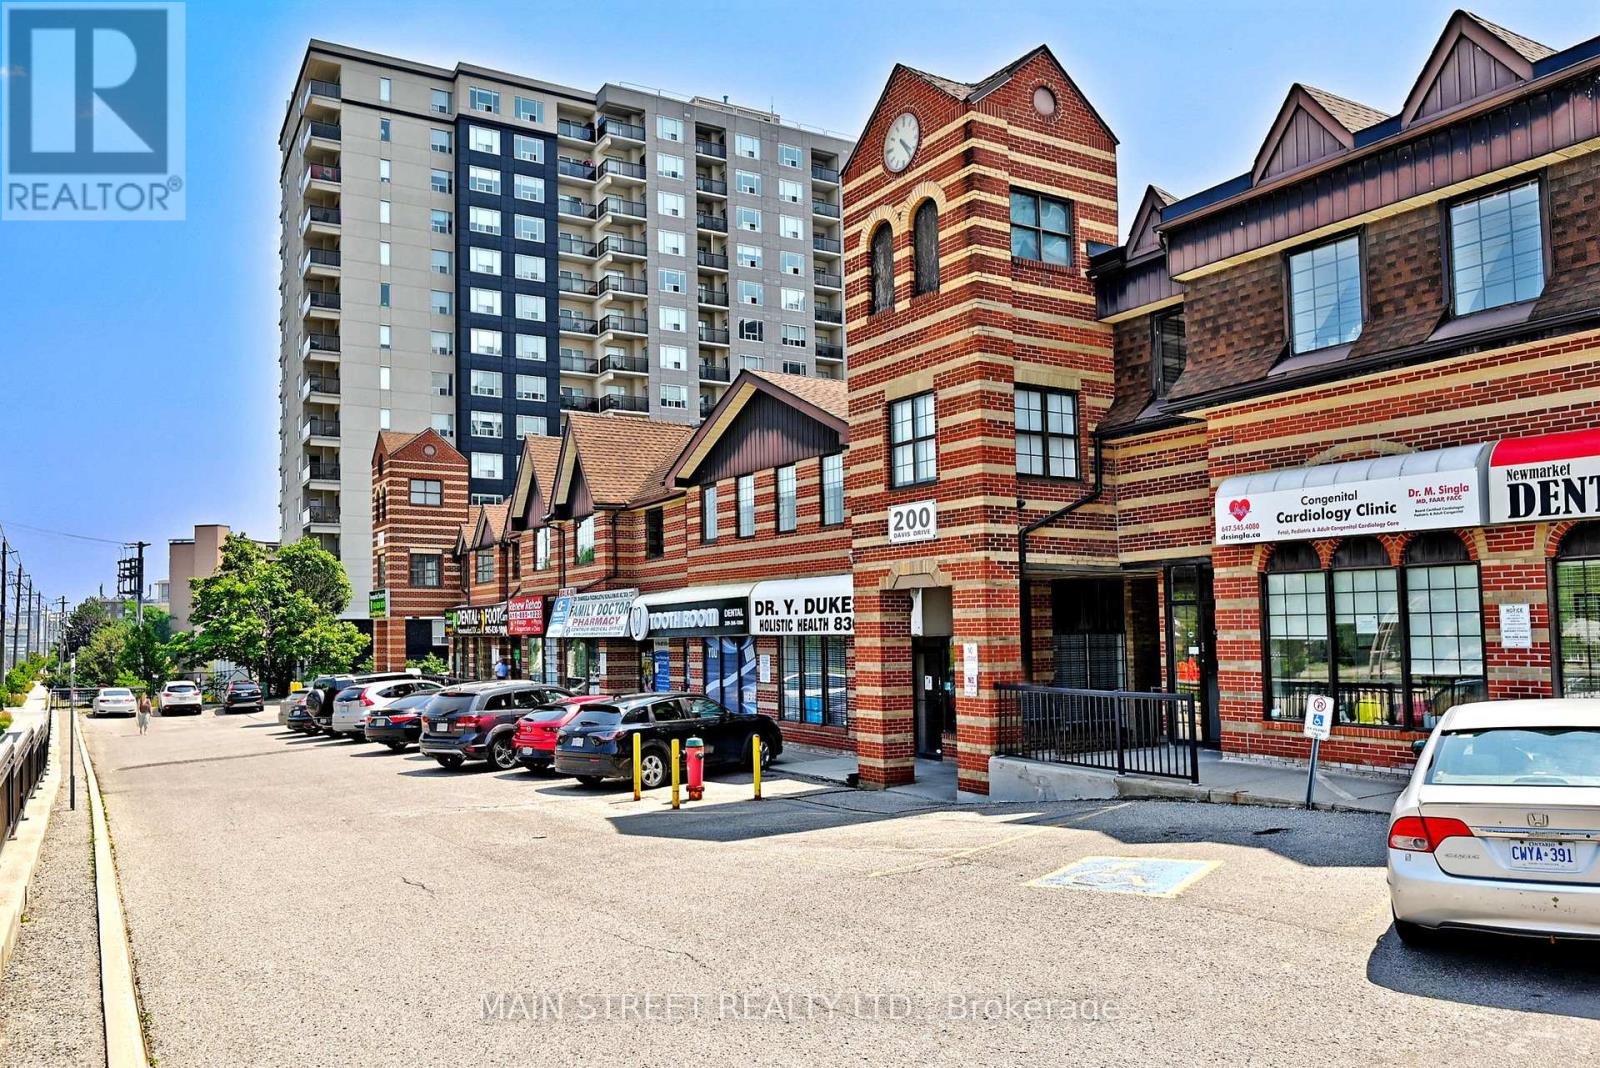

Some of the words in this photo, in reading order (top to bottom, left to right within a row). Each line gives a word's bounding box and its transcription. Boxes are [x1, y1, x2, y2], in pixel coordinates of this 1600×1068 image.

[1506, 462, 1571, 482] Newmarket
[1301, 490, 1358, 506] Congenital
[1408, 488, 1421, 498] Dr.
[1424, 486, 1436, 496] M.
[1438, 483, 1470, 496] Singla
[893, 507, 931, 531] 200
[1276, 507, 1352, 525] Cardiology
[1356, 501, 1397, 517] Clinic
[1358, 521, 1386, 530] Cardiology
[1221, 532, 1261, 541] drsingla.ca
[569, 604, 597, 617] FAMILY
[596, 601, 631, 616] DOCTOR
[723, 607, 744, 618] DENTAL
[755, 599, 779, 616] DR.
[785, 599, 798, 614] Y.
[804, 595, 856, 614] DUKE
[456, 608, 478, 626] DENTAL
[484, 607, 501, 625] FOOT
[572, 616, 621, 626] PHARMACY
[649, 611, 686, 630] TOOTH
[759, 619, 793, 632] HOLISTIC
[797, 616, 829, 632] HEALTH
